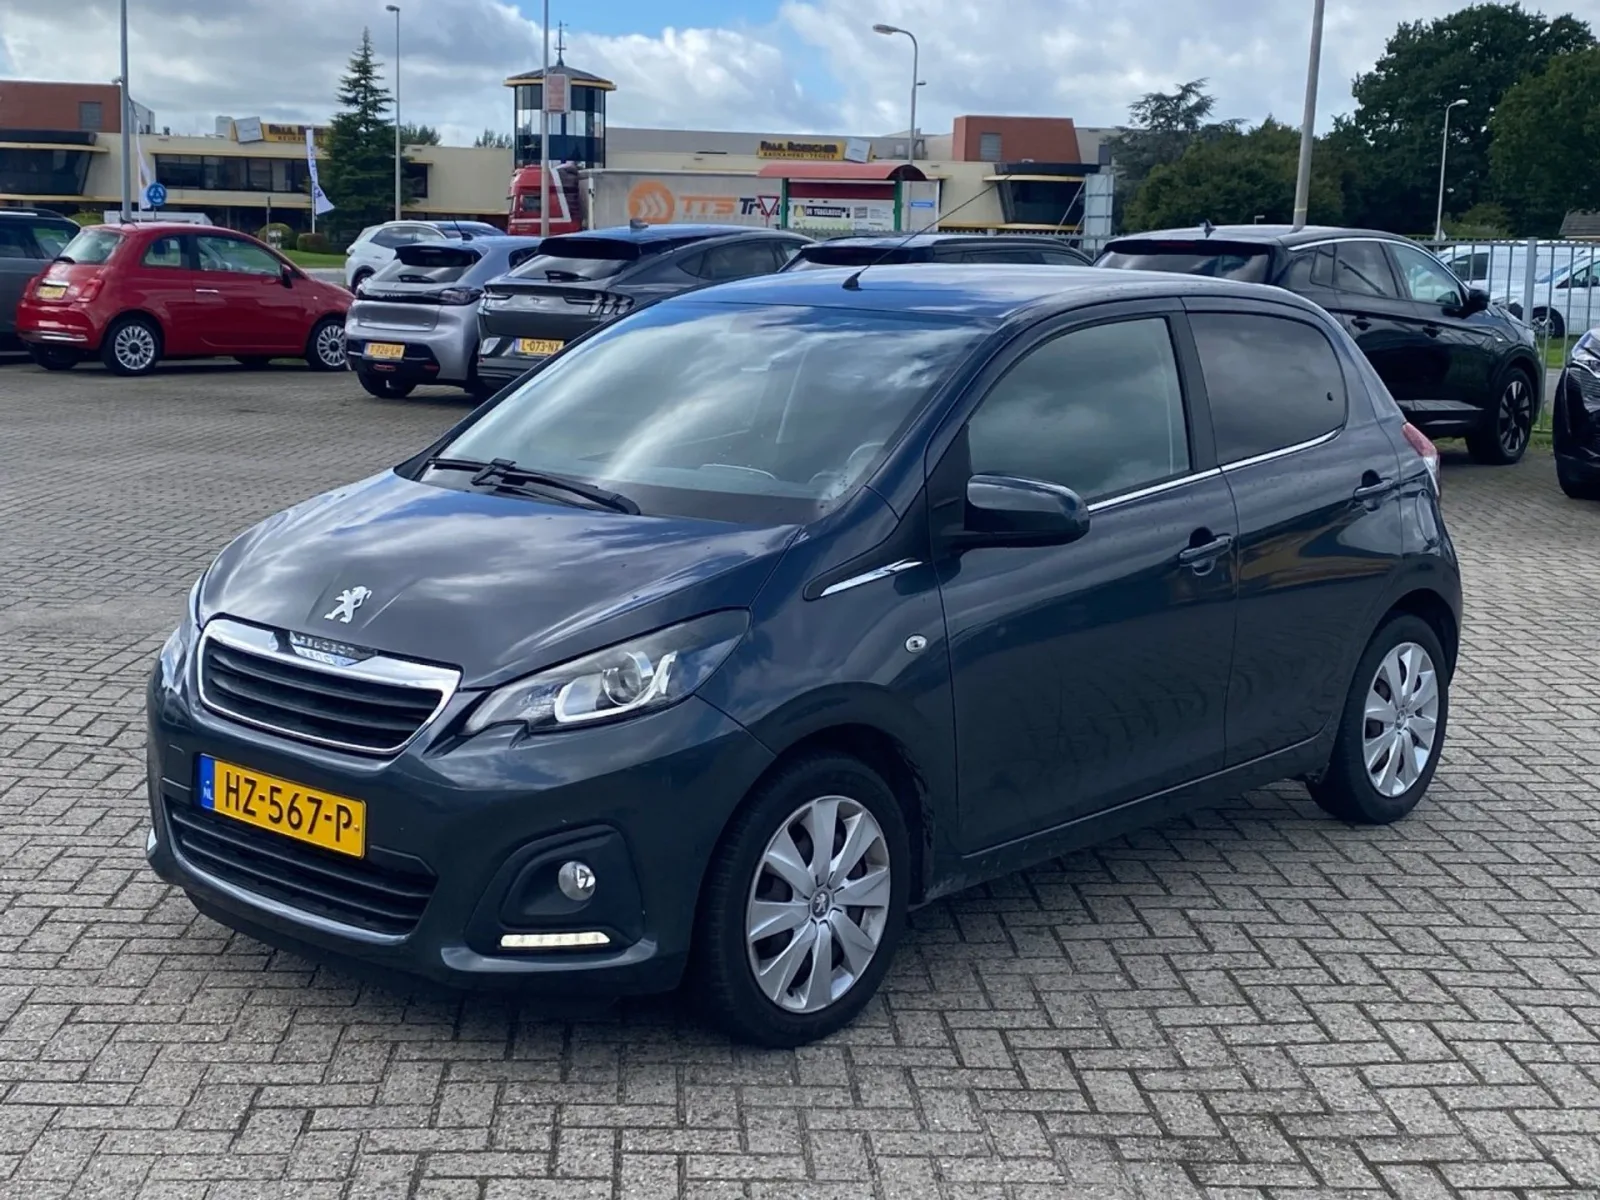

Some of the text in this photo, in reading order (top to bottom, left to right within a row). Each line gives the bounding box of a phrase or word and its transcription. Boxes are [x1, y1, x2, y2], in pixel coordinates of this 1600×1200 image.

[680, 196, 738, 214] TTS
[202, 787, 214, 800] NL
[225, 771, 353, 842] HZ-567-P
